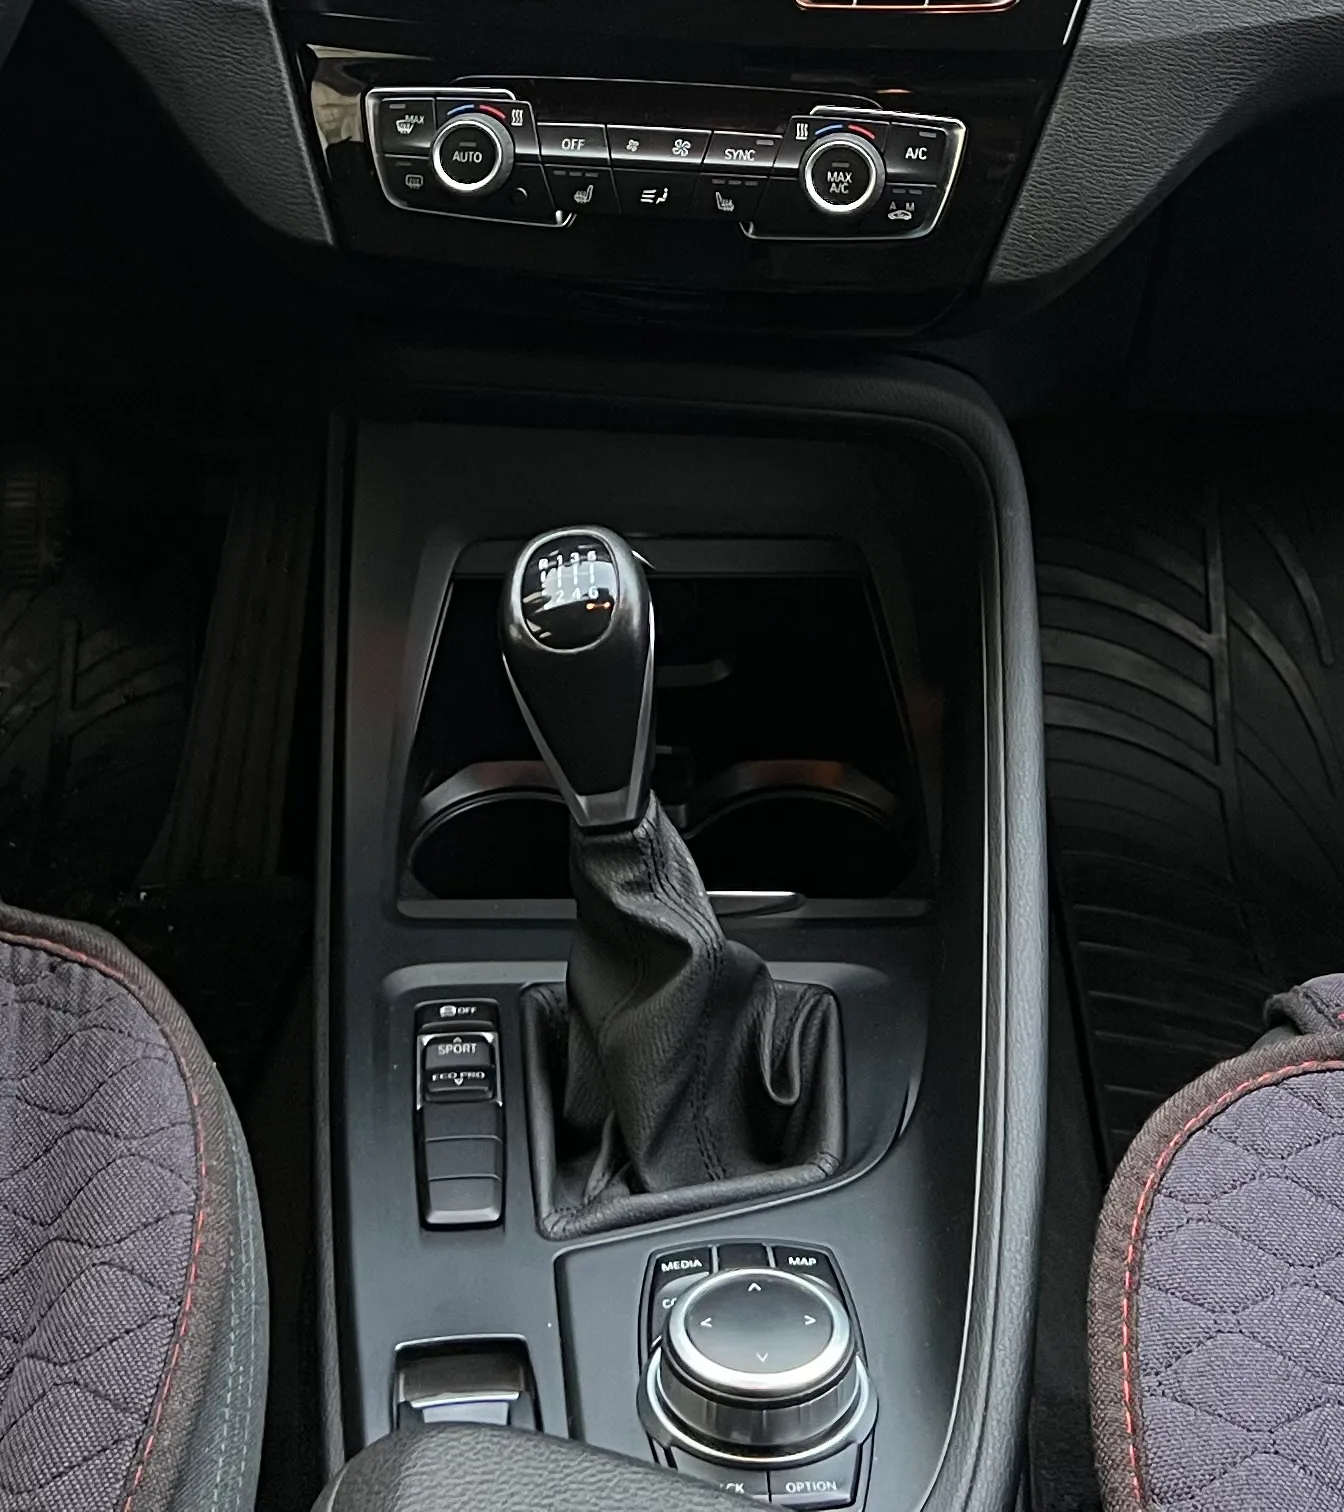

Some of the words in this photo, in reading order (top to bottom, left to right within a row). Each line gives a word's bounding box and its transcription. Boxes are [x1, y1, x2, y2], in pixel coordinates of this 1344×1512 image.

[405, 114, 425, 124] MAX
[561, 138, 586, 151] OFF
[452, 151, 483, 163] AUTO
[724, 148, 756, 161] SYNC
[905, 146, 928, 160] A/C
[827, 171, 852, 183] MAX
[829, 182, 849, 194] A/C
[889, 201, 897, 210] A
[906, 202, 915, 211] M
[557, 554, 563, 565] 1
[570, 552, 580, 563] 3
[556, 590, 565, 601] 2
[588, 586, 599, 599] 6
[438, 1043, 477, 1055] SPORT
[661, 1259, 703, 1272] MEDIA
[788, 1256, 817, 1266] MAP
[785, 1480, 837, 1494] OPTION
